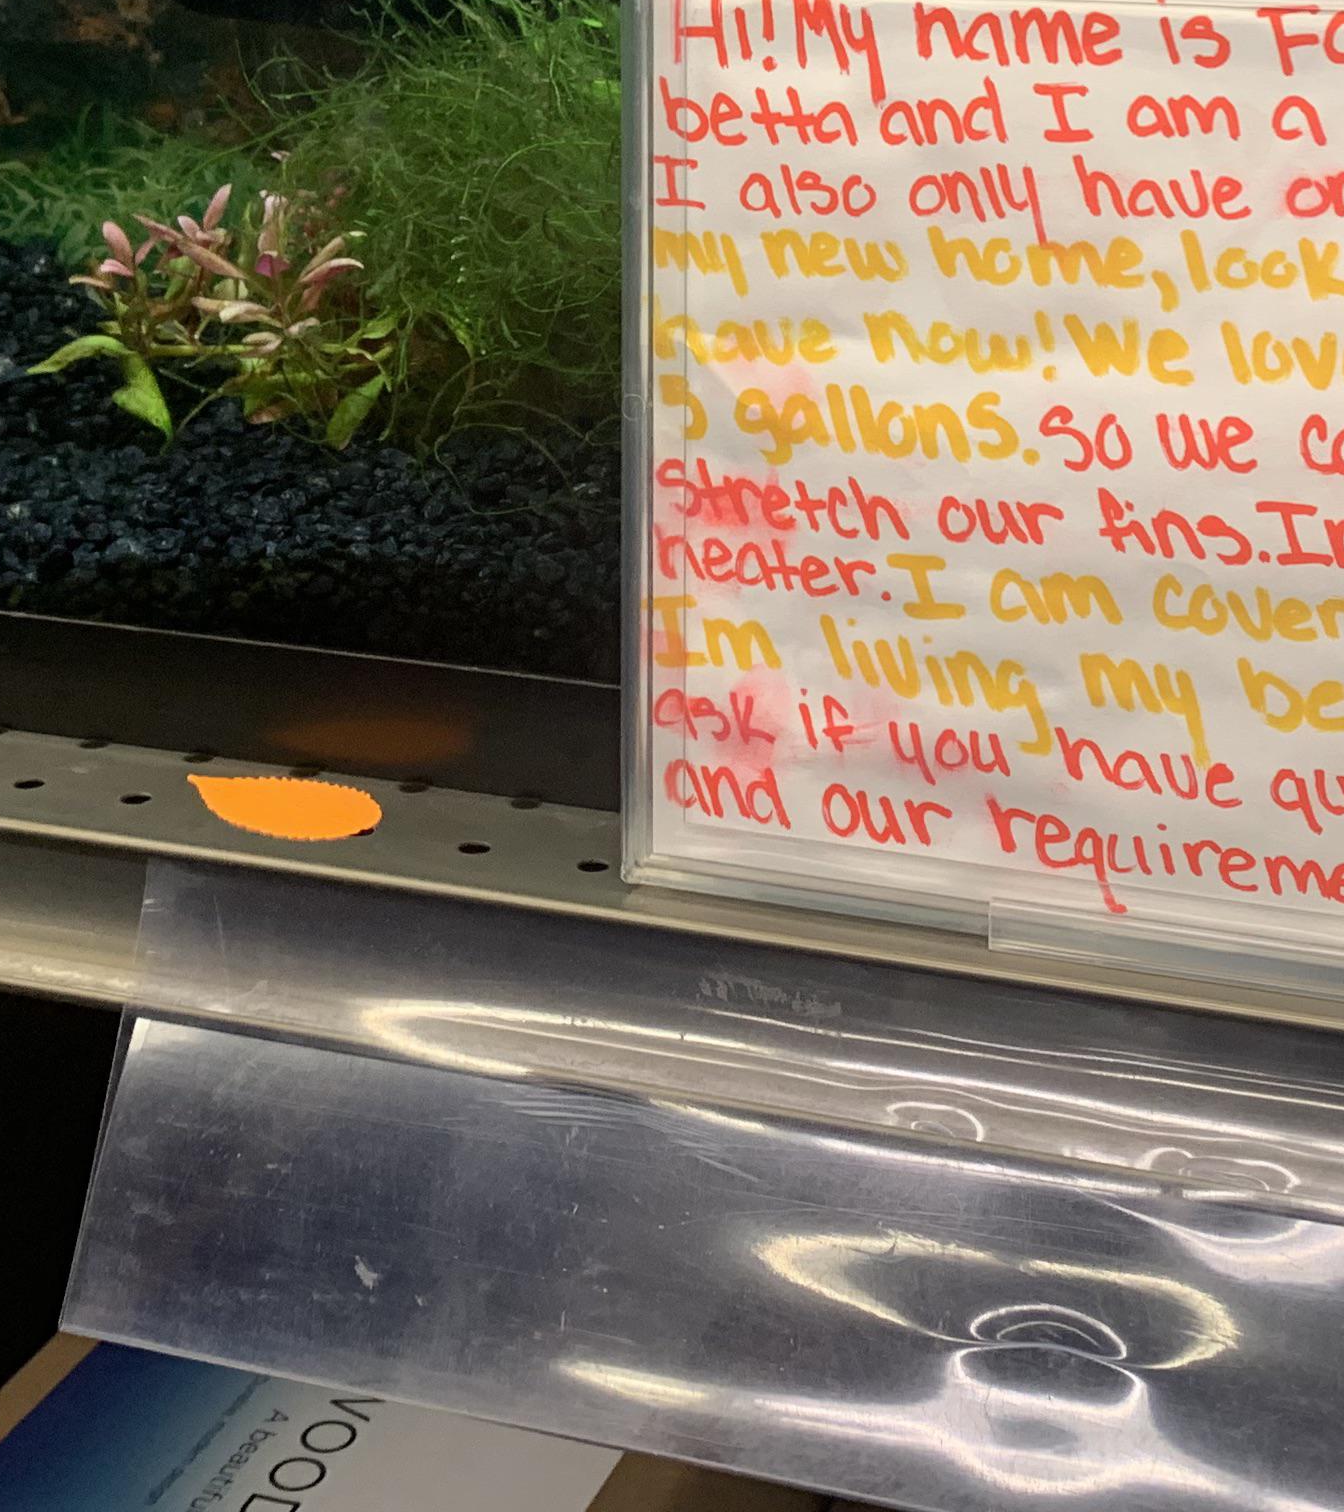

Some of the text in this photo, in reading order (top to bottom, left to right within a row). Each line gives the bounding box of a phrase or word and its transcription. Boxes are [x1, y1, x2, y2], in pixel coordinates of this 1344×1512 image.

[914, 1, 1124, 66] name
[659, 75, 859, 146] betta
[879, 75, 1008, 146] and
[1033, 81, 1094, 143] I
[1127, 93, 1241, 141] am
[1271, 95, 1327, 146] a
[653, 155, 706, 211] I
[739, 163, 877, 218] also
[909, 162, 1050, 249] only
[1072, 154, 1253, 221] have
[653, 225, 749, 297] my
[760, 228, 910, 283] new
[652, 294, 839, 367] have
[1156, 412, 1258, 474] we
[655, 457, 911, 541] stretch
[937, 494, 1065, 545] our
[887, 552, 967, 620] I
[989, 567, 1125, 626] am
[819, 613, 1055, 756] living
[1079, 651, 1212, 769] my
[653, 687, 777, 745] ask
[798, 688, 855, 752] if
[888, 720, 1012, 787] you
[1054, 725, 1243, 809] have
[664, 757, 792, 831] and
[820, 782, 954, 847] our
